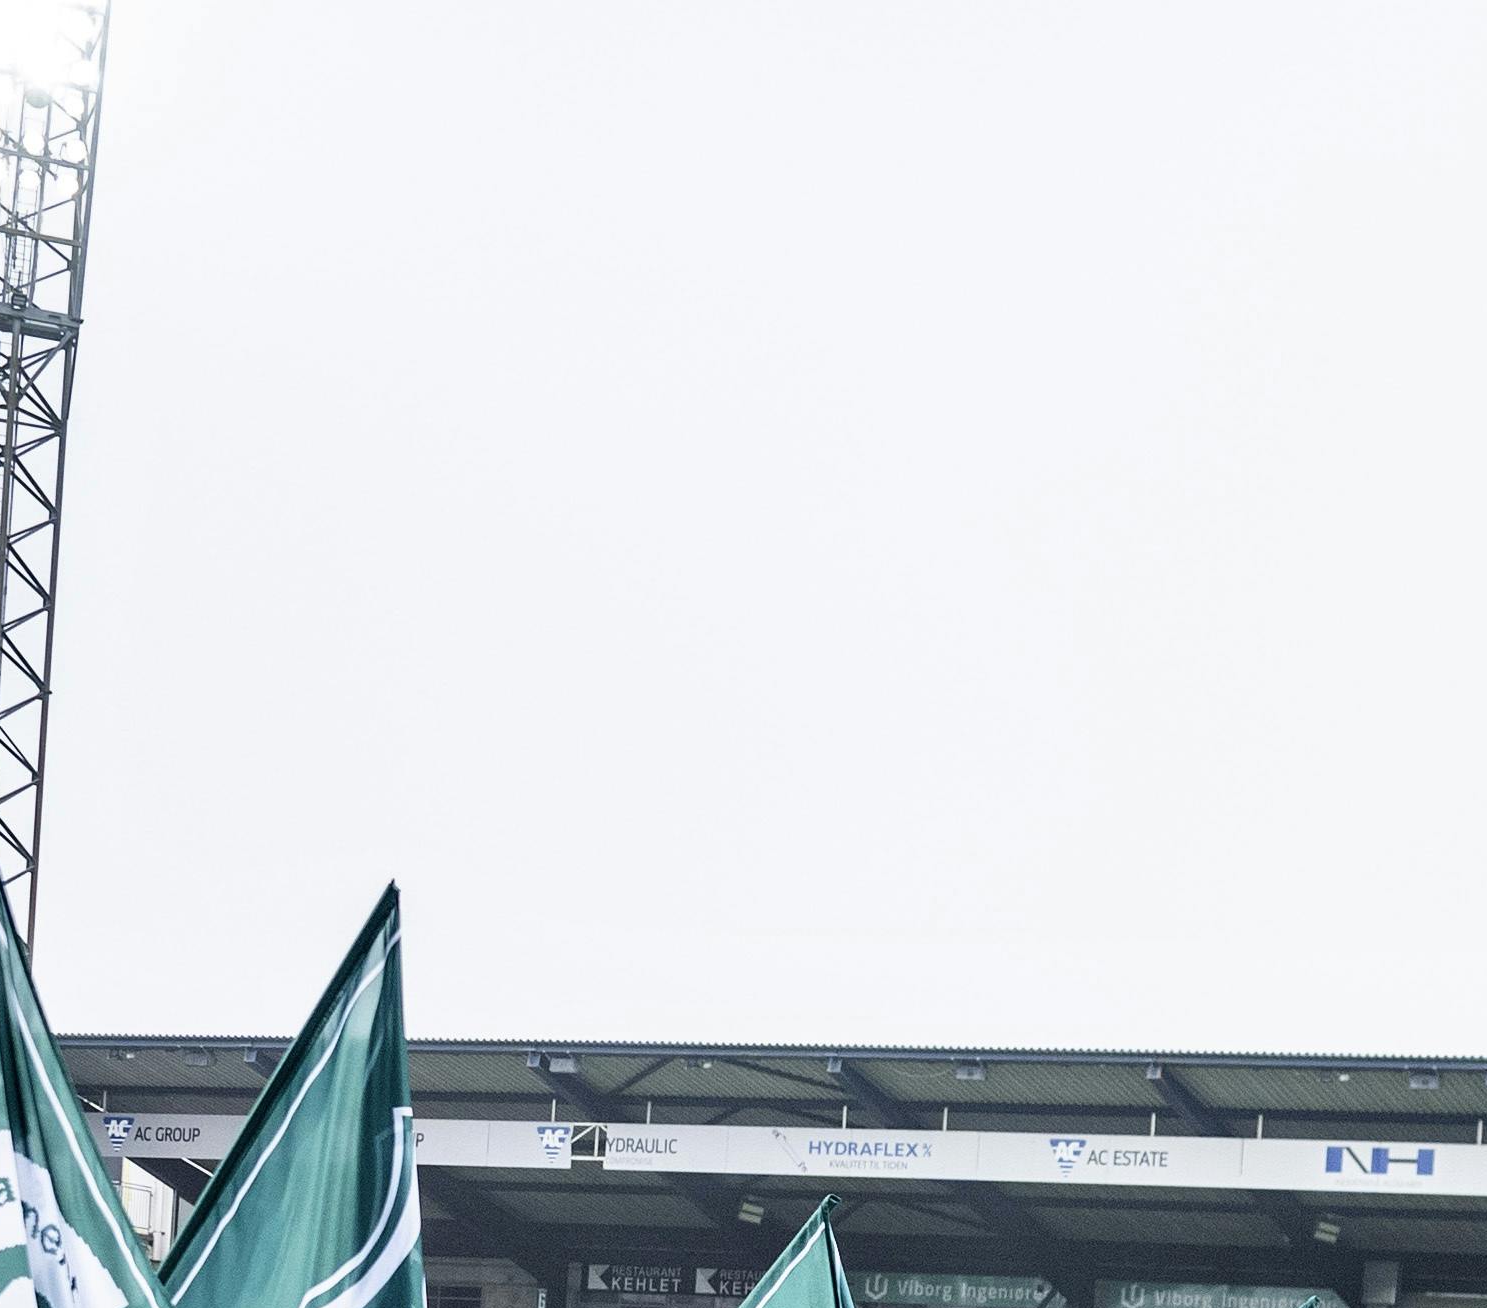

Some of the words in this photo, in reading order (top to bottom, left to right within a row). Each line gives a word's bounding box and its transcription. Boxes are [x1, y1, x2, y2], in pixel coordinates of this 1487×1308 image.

[134, 1127, 151, 1142] AC
[155, 1126, 201, 1143] GROUP
[808, 1140, 918, 1159] HYDRAFLEX
[1087, 1151, 1108, 1166] AC
[1113, 1151, 1169, 1168] ESTATE
[614, 1264, 682, 1279] RESTAURANT
[612, 1276, 682, 1293] KEHLET
[898, 1279, 953, 1303] Viborg
